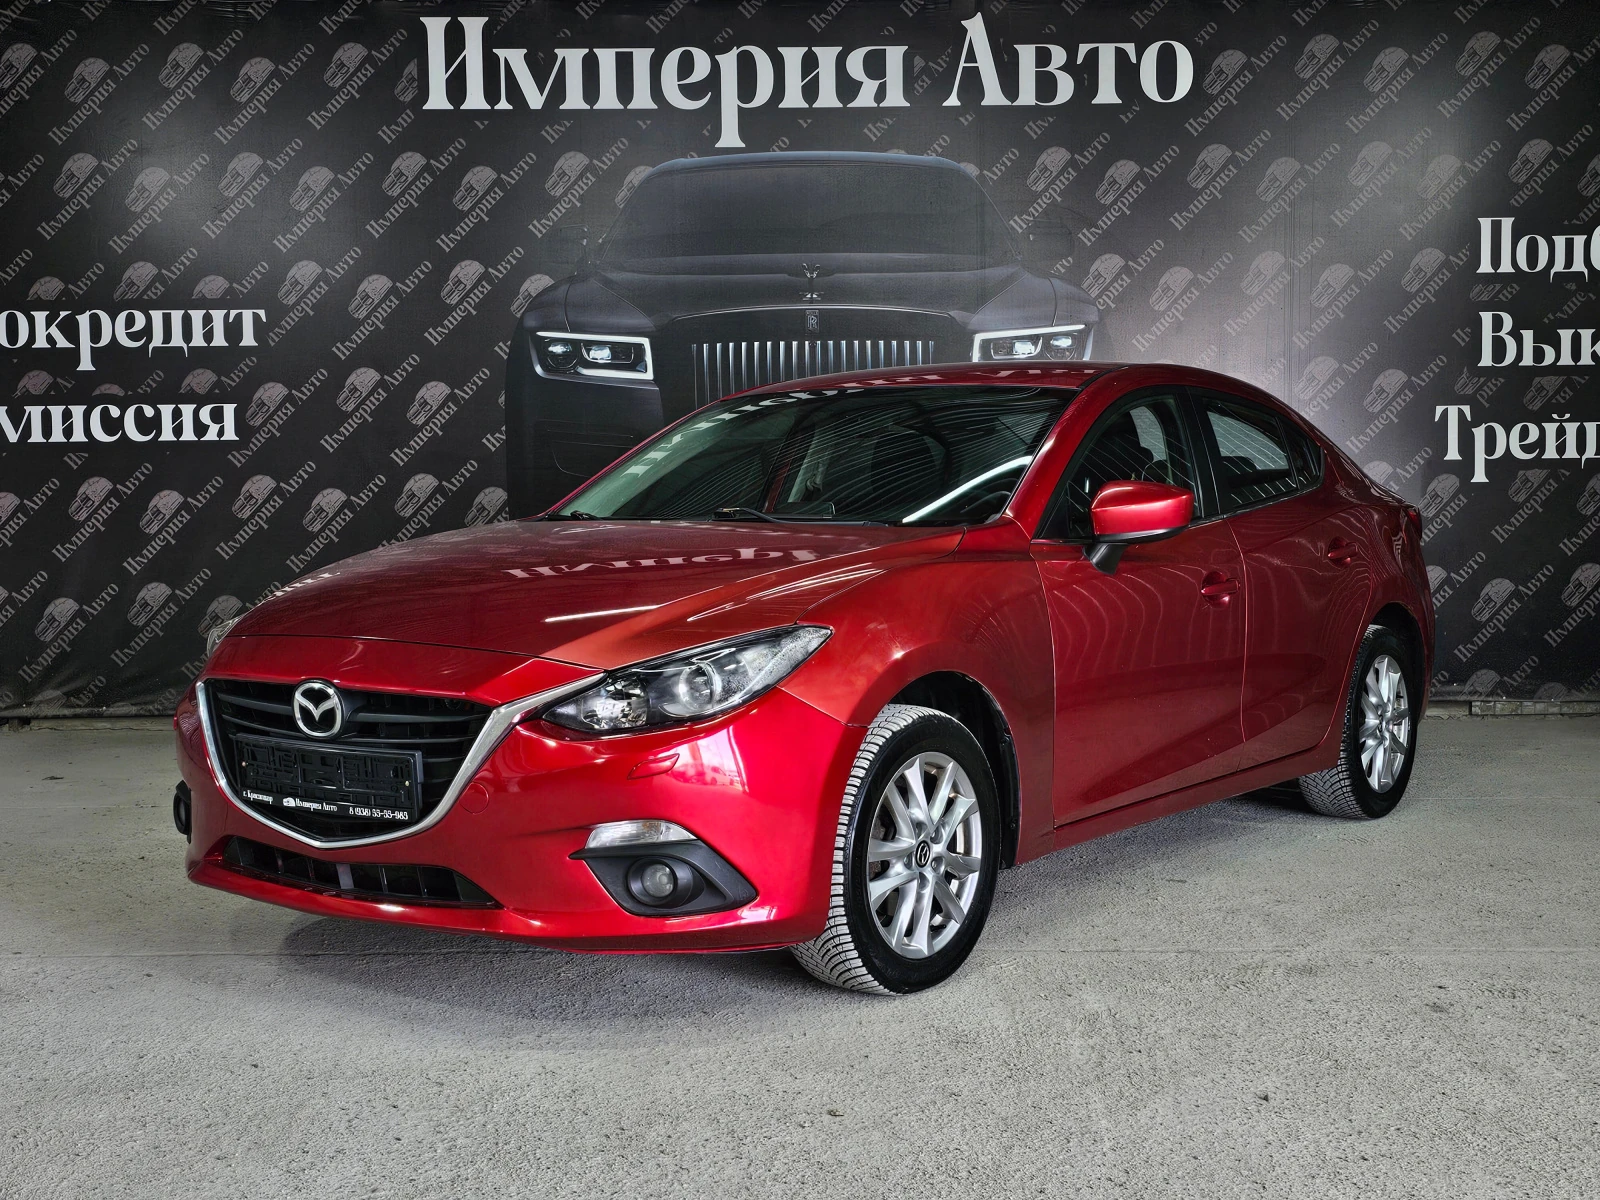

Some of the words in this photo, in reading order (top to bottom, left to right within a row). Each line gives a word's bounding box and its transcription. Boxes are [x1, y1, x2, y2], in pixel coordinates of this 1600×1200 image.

[40, 29, 78, 67] Авто
[48, 78, 117, 146] Империя
[112, 43, 150, 81] Авто
[142, 63, 211, 131] Империя
[206, 28, 244, 66] Авто
[214, 77, 283, 145] Империя
[277, 42, 315, 80] Авто
[307, 63, 376, 131] Империя
[370, 28, 408, 66] Авто
[420, 16, 911, 148] Империя
[943, 12, 1194, 108] Авто
[1185, 70, 1254, 138] Империя
[1249, 34, 1287, 72] Авто
[1277, 54, 1346, 122] Империя
[1342, 19, 1380, 57] Авто
[1346, 67, 1415, 135] Империя
[1411, 32, 1449, 70] Авто
[1438, 52, 1507, 120] Империя
[1503, 16, 1541, 54] Авто
[1507, 65, 1576, 133] Империя
[1555, 123, 1593, 161] Авто
[7, 153, 45, 191] Авто
[37, 173, 106, 241] Империя
[101, 138, 139, 176] Авто
[108, 187, 177, 255] Империя
[172, 152, 210, 190] Авто
[202, 172, 271, 240] Империя
[265, 137, 303, 175] Авто
[273, 186, 342, 254] Империя
[336, 151, 374, 189] Авто
[365, 171, 434, 239] Империя
[429, 137, 467, 175] Авто
[436, 186, 505, 254] Империя
[499, 151, 537, 189] Авто
[528, 171, 597, 239] Империя
[591, 137, 629, 175] Авто
[982, 147, 1020, 185] Авто
[1009, 167, 1078, 235] Империя
[1073, 131, 1111, 169] Авто
[1078, 180, 1147, 248] Империя
[1142, 144, 1180, 182] Авто
[1170, 164, 1239, 232] Империя
[1234, 129, 1272, 167] Авто
[1303, 142, 1341, 180] Авто
[1463, 139, 1501, 177] Авто
[67, 262, 105, 300] Авто
[160, 246, 198, 284] Авто
[231, 260, 269, 298] Авто
[324, 246, 362, 284] Авто
[425, 281, 490, 345] Империя
[487, 245, 525, 283] Авто
[1127, 238, 1165, 276] Авто
[1476, 217, 1600, 282] Под
[0, 309, 266, 371] окредит
[331, 294, 400, 362] Империя
[395, 260, 433, 298] Авто
[1132, 286, 1201, 354] Империя
[1196, 251, 1234, 289] Авто
[1292, 283, 1361, 351] Империя
[1356, 248, 1394, 286] Авто
[1383, 267, 1452, 335] Империя
[220, 354, 258, 392] Авто
[321, 388, 386, 452] Империя
[383, 353, 421, 391] Авто
[1341, 341, 1379, 379] Авто
[1410, 354, 1448, 392] Авто
[0, 403, 239, 442] миссия
[227, 401, 296, 469] Империя
[290, 367, 328, 405] Авто
[391, 402, 456, 466] Империя
[454, 367, 490, 403] Авто
[1395, 446, 1433, 484] Авто
[22, 477, 60, 515] Авто
[52, 496, 121, 564] Империя
[115, 462, 153, 500] Авто
[123, 509, 192, 577] Империя
[186, 475, 224, 513] Авто
[215, 494, 284, 562] Империя
[279, 460, 317, 498] Авто
[287, 508, 352, 572] Империя
[350, 474, 386, 510] Авто
[441, 459, 479, 497] Авто
[1492, 479, 1557, 543] Империя
[11, 570, 49, 608] Авто
[81, 582, 119, 620] Авто
[111, 601, 180, 669] Империя
[174, 567, 212, 605] Авто
[1450, 551, 1486, 587] Авто
[1455, 598, 1520, 662] Империя
[1518, 564, 1554, 600] Авто
